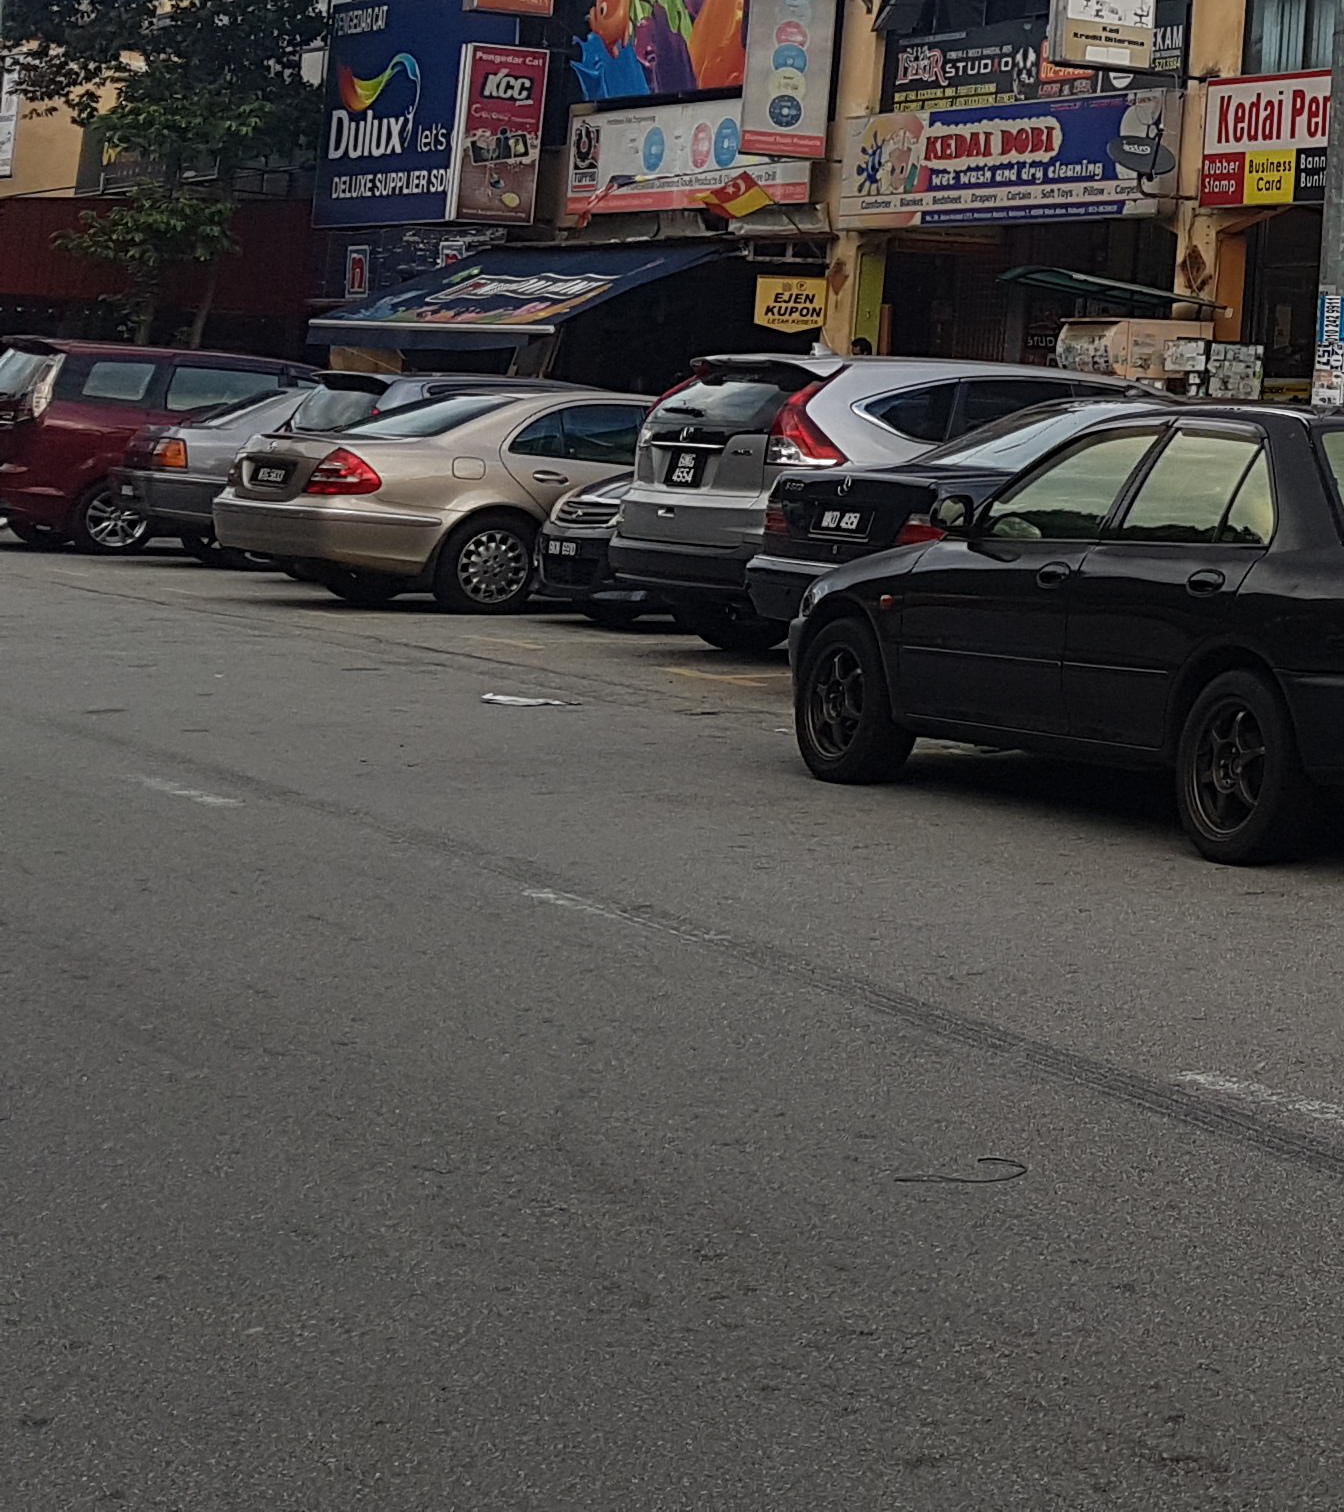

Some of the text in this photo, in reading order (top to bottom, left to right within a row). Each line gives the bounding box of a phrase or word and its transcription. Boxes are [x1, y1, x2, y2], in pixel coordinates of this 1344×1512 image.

[373, 6, 388, 30] CAT
[476, 52, 543, 66] Pengedar Cat
[483, 69, 531, 99] KCC
[1217, 91, 1284, 144] Kedai
[328, 110, 446, 159] Dulux let's
[924, 125, 1056, 162] KEDAI DOBI
[931, 160, 1103, 187] wet wash and dry cleaning
[1204, 160, 1239, 174] Rubber
[1249, 158, 1292, 174] Business
[332, 171, 427, 199] DELUXE SUPPLIER
[1204, 179, 1236, 195] Stamp
[1256, 176, 1282, 191] Card
[971, 193, 998, 205] Drapery
[774, 293, 815, 304] EJEN
[765, 305, 822, 318] KUPON
